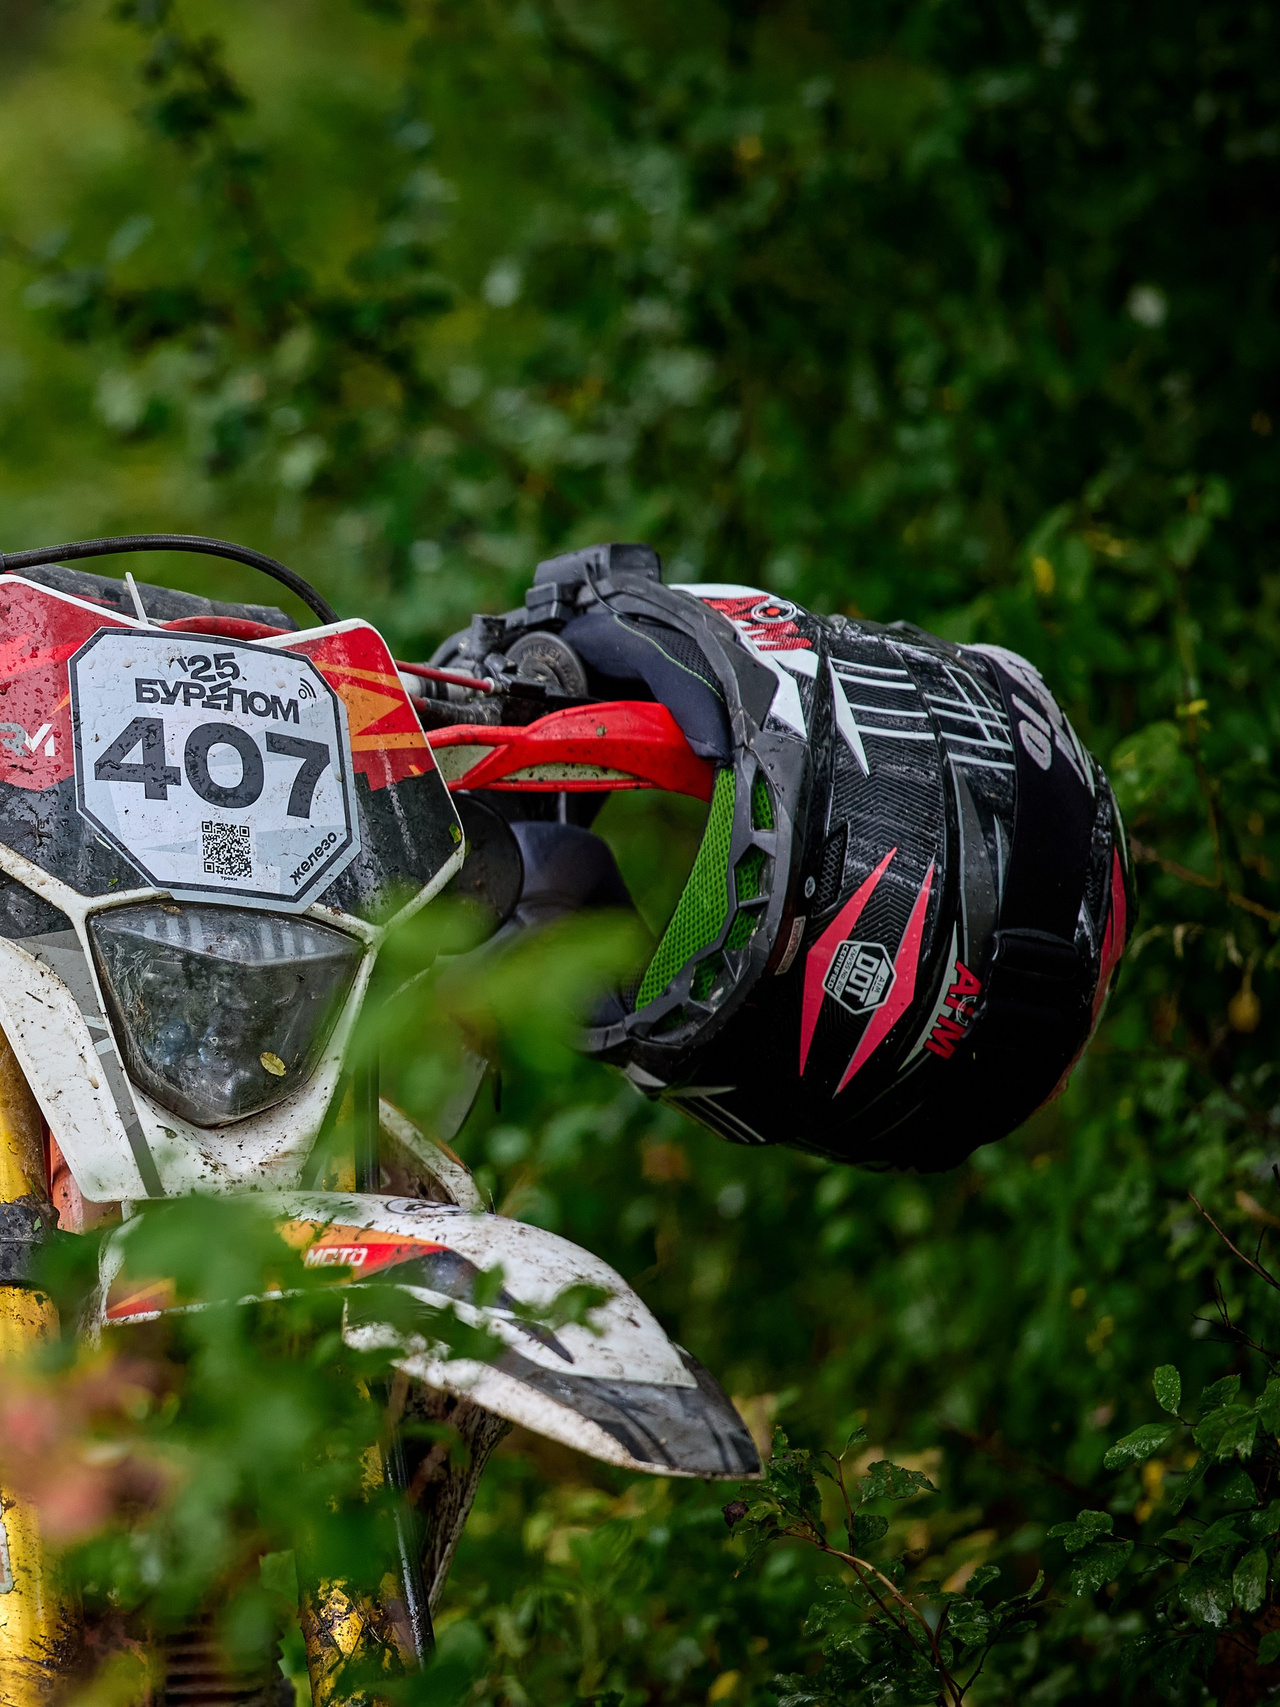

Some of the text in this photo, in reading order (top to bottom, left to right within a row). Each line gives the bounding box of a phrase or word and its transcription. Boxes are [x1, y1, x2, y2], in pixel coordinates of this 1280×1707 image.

[94, 716, 331, 819] 407
[289, 832, 337, 885] железо
[827, 944, 850, 989] CERTIFIED
[845, 951, 881, 1003] DOT
